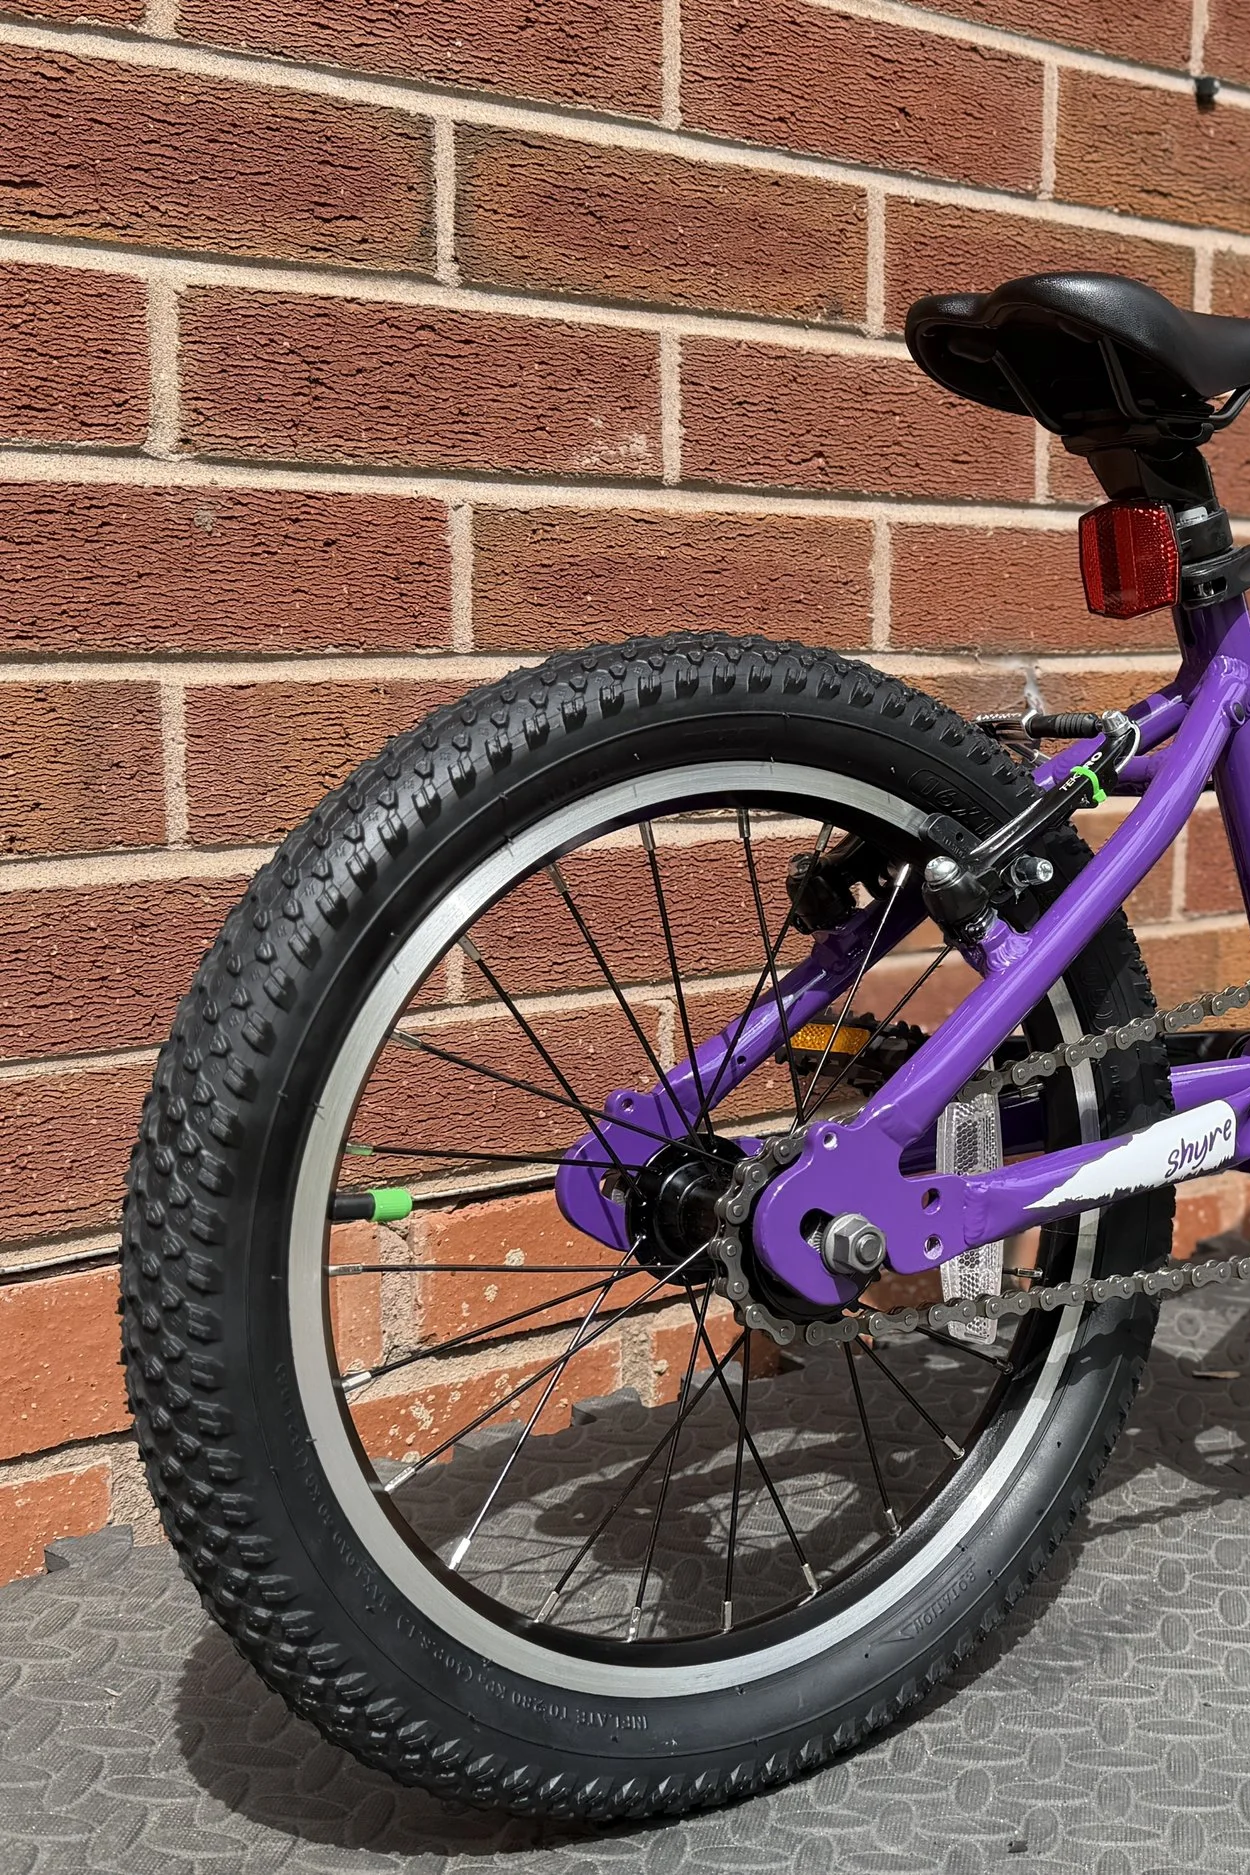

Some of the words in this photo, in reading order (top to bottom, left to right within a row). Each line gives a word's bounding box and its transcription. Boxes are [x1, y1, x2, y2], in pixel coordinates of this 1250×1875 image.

[1059, 751, 1103, 791] TEKRO
[1164, 1117, 1233, 1179] shyre
[912, 1566, 978, 1635] ROTATION
